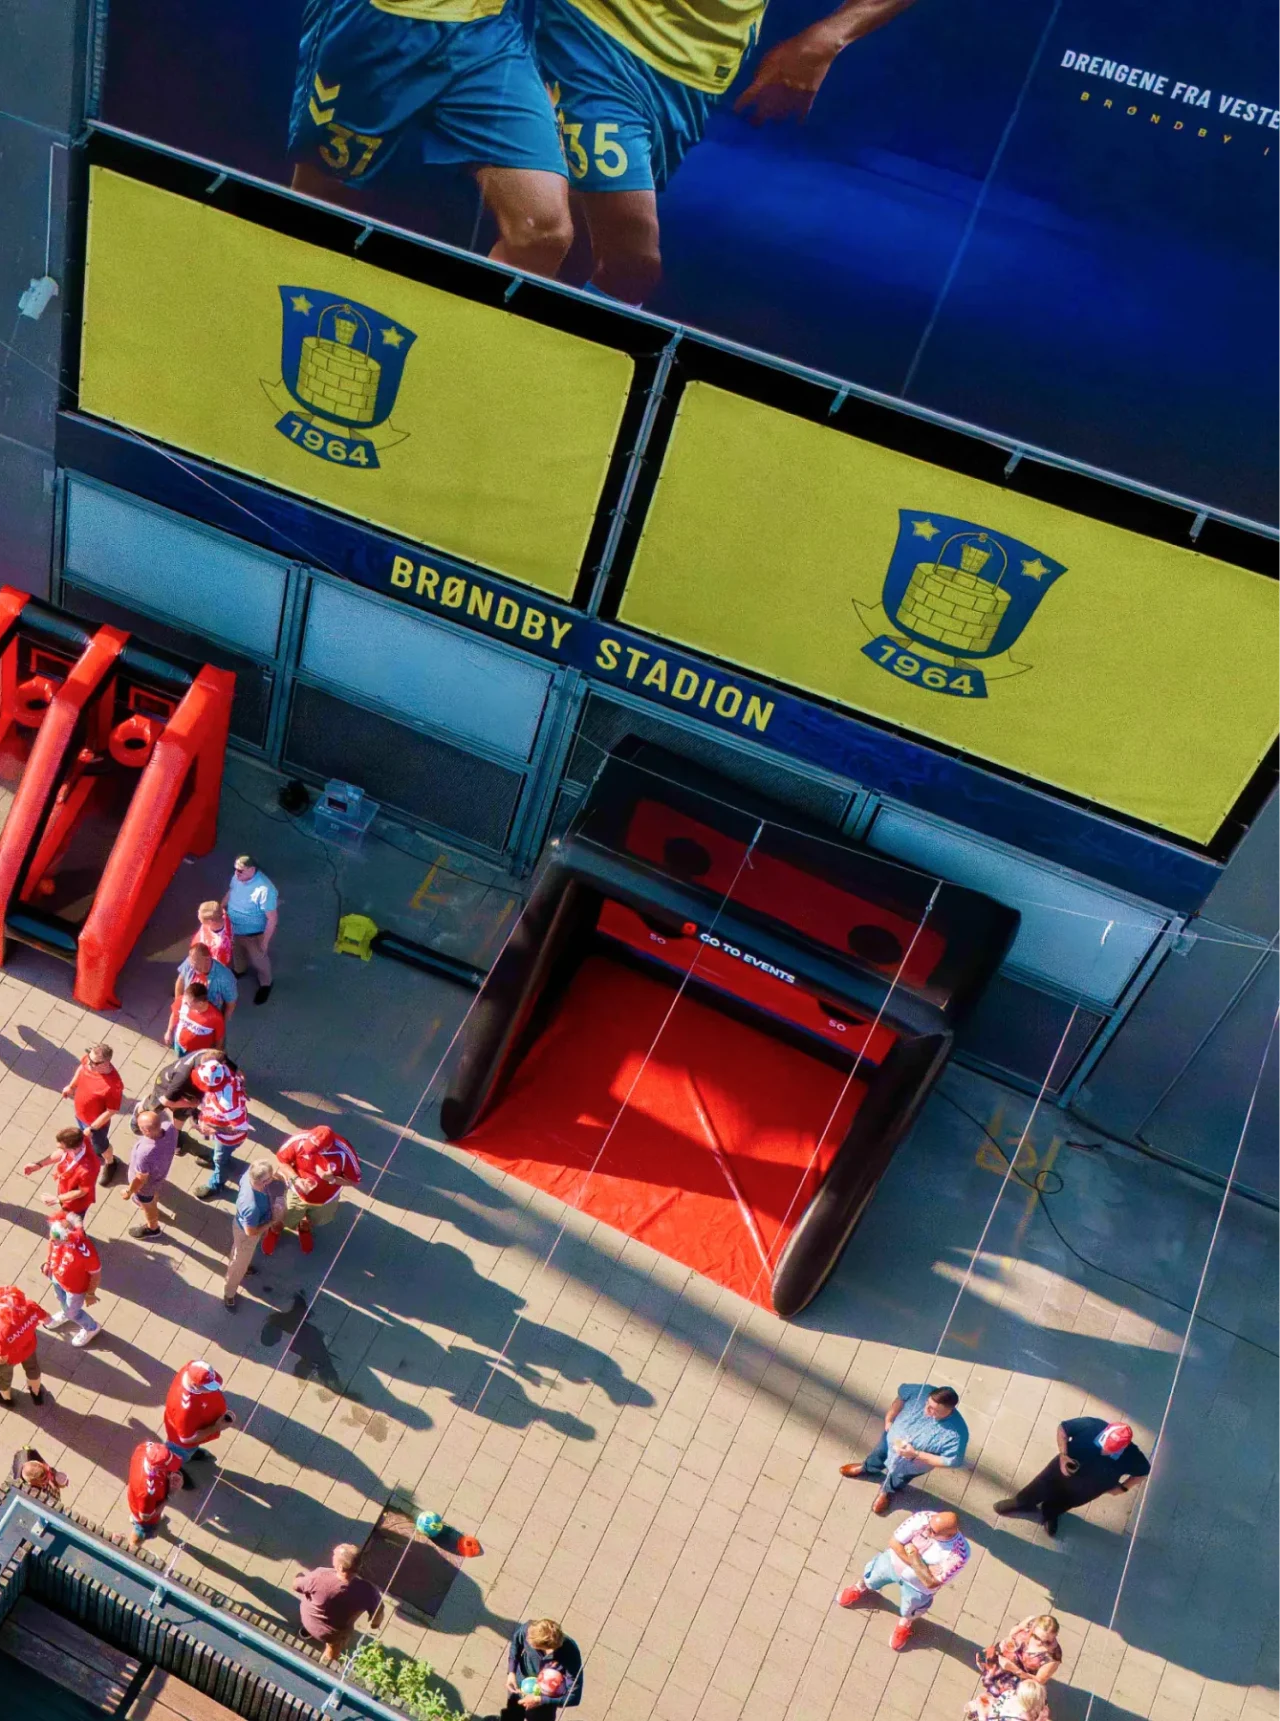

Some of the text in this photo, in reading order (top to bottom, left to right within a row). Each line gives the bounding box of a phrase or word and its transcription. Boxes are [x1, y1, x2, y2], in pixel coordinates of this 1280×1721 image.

[1060, 50, 1280, 130] DRENGENE FRA VESTE
[319, 122, 383, 176] 37
[562, 122, 628, 178] 35
[290, 420, 369, 466] 1964
[390, 555, 775, 732] BRØNDBY STADION
[878, 644, 974, 695] 1964
[700, 933, 795, 983] GO TO EVENTS
[7, 1312, 38, 1343] DANMARK
